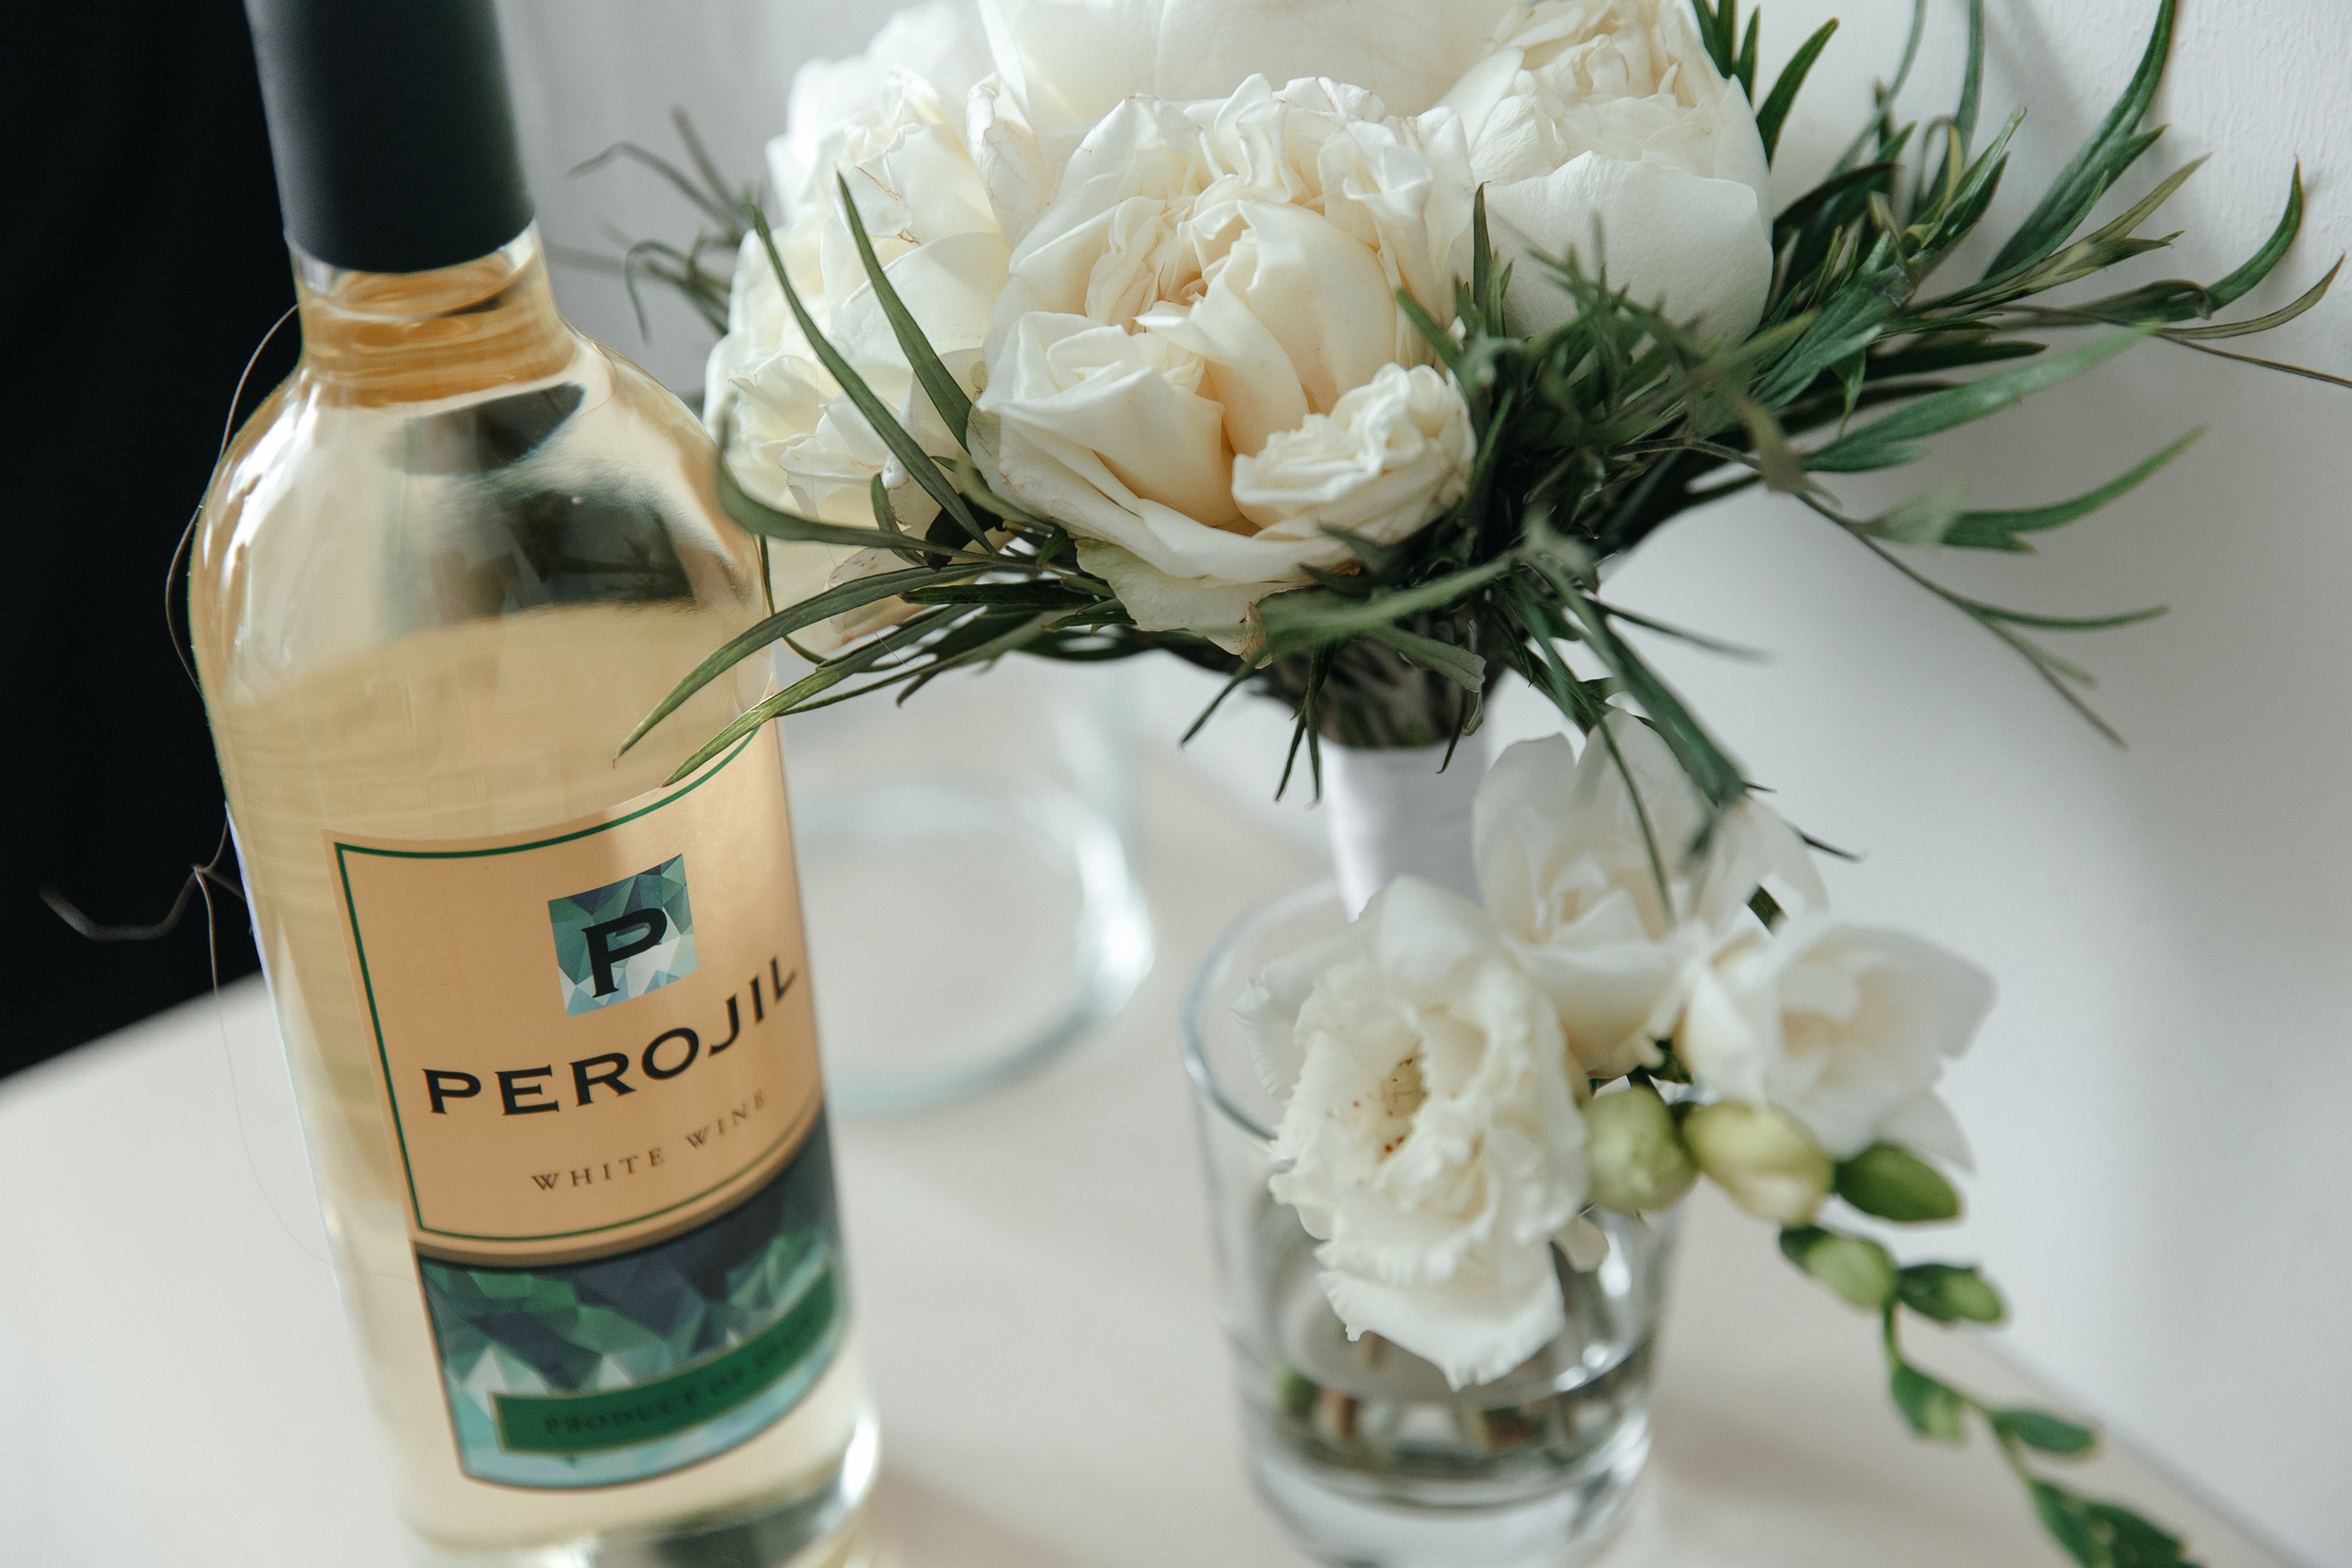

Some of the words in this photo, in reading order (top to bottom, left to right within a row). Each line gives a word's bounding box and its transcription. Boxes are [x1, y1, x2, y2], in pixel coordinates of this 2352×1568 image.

[581, 907, 669, 999] P
[421, 955, 798, 1116] PEROJIL
[530, 1147, 664, 1192] WHITE
[684, 1089, 765, 1148] WINE
